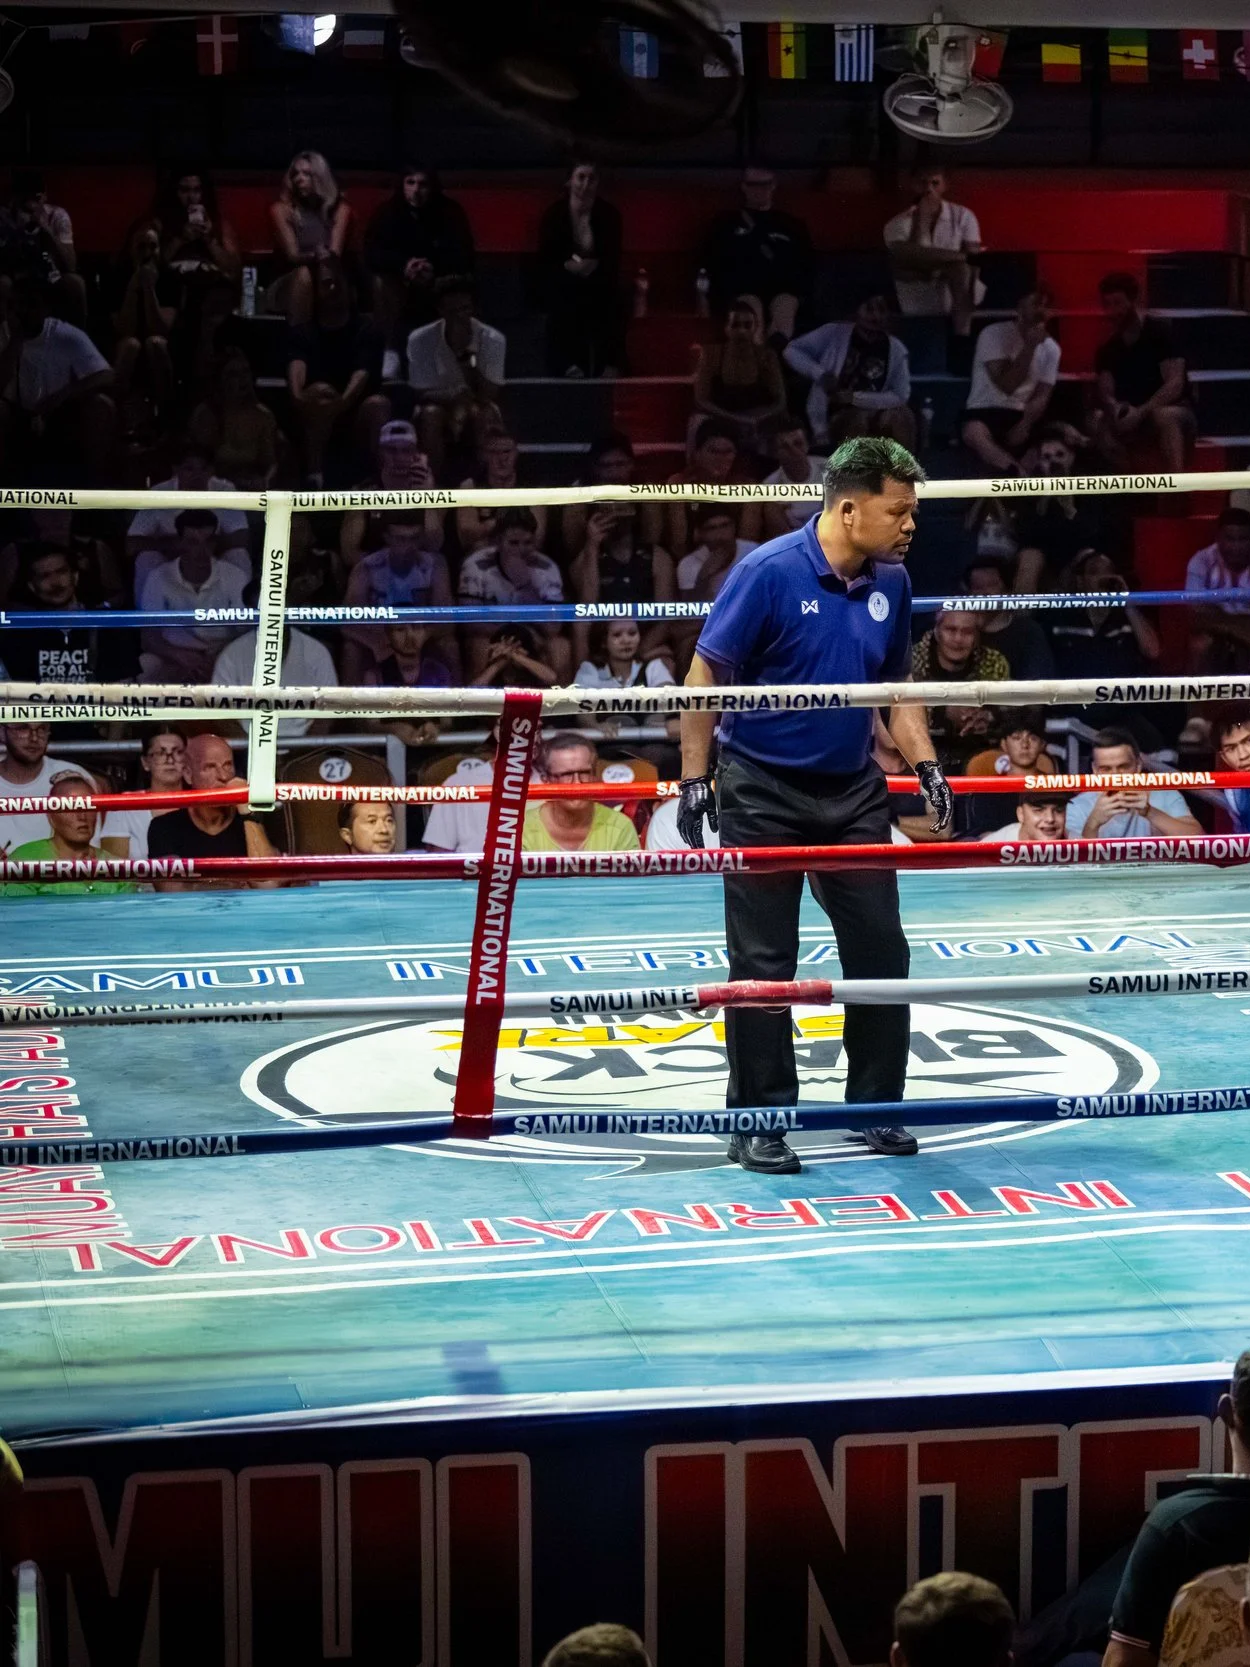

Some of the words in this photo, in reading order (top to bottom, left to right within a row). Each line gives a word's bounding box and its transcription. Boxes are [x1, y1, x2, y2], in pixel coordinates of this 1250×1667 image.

[991, 479, 1044, 492] SAMUI
[1050, 476, 1178, 491] INTERNATIONAL
[321, 491, 457, 507] INTERNATIONAL
[267, 549, 285, 607] SAMUI
[194, 607, 254, 621] SAMUI
[575, 603, 632, 618] SAMUI
[667, 693, 850, 711] INTERNATIONAL
[1095, 684, 1171, 702] SAMUI
[323, 759, 346, 779] 27
[502, 717, 532, 801] SAMUI
[1024, 774, 1080, 790] SAMUI
[1085, 771, 1215, 788] INTERNATIONAL
[277, 786, 337, 802] SAMUI
[341, 785, 480, 802] INTERNATIONAL
[463, 853, 553, 876] SUI
[556, 851, 750, 874] INTERNATIONAL
[1000, 843, 1078, 864] SAMUI
[0, 858, 202, 880] INTERNATIONAL
[476, 807, 519, 1006] INTERNATIONAL
[1089, 974, 1169, 995] SAMUI
[549, 990, 629, 1014] SAMUI
[1056, 1094, 1136, 1118] SAMUI
[514, 1114, 597, 1136] SAMUI
[606, 1109, 803, 1135] INTERNATIONAL
[38, 1134, 245, 1165] INTERNATIONAL
[70, 1178, 1137, 1273] INTERNATIONAL
